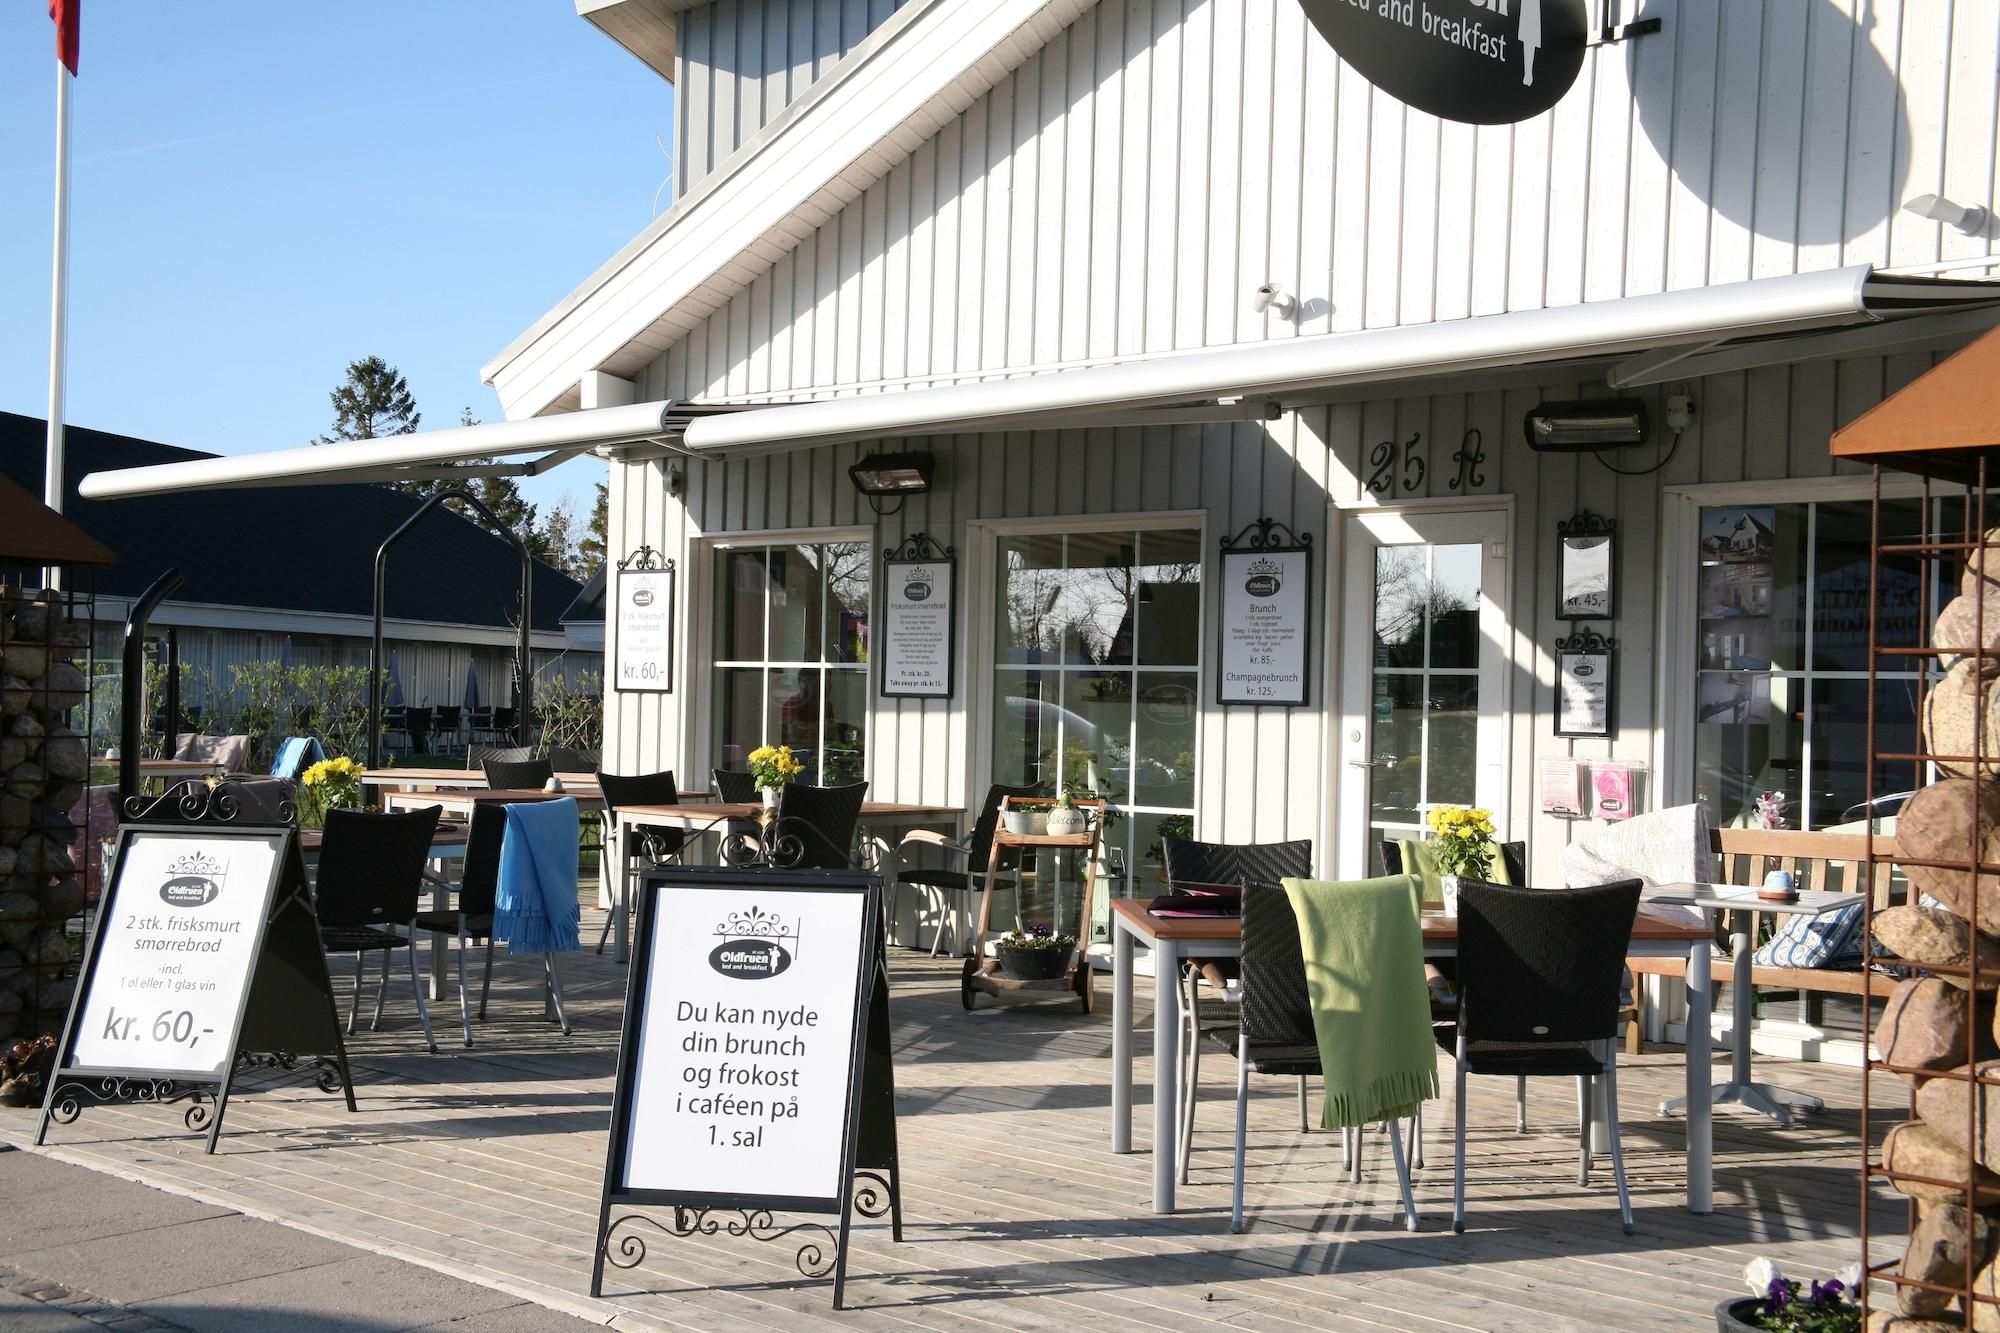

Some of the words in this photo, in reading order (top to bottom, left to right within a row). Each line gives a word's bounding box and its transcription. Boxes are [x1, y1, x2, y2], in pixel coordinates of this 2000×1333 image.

[1378, 0, 1413, 27] and
[1421, 3, 1507, 63] breakfast
[1365, 431, 1425, 492] 25
[1250, 603, 1277, 613] Brunch
[1583, 594, 1606, 608] 45,-
[1250, 656, 1259, 664] kr.
[1261, 656, 1276, 666] 85,-
[624, 661, 638, 679] kr.
[642, 662, 664, 681] 60,-
[1226, 672, 1298, 684] Champagnebrunch
[1246, 686, 1256, 695] kr.
[1258, 687, 1276, 697] 125,-
[168, 885, 203, 896] Oldfruen
[126, 915, 136, 929] 2
[138, 915, 163, 931] stk.
[167, 915, 241, 933] frisksmurt
[133, 937, 221, 953] smørrebrød
[720, 951, 768, 964] Oldfruen
[158, 963, 183, 975] -incl.
[121, 977, 126, 988] 1
[128, 977, 138, 988] øl
[140, 978, 164, 989] eller
[167, 979, 172, 989] 1
[174, 979, 197, 993] glas
[199, 981, 216, 991] vin
[676, 1001, 708, 1022] Du
[715, 1002, 755, 1025] kan
[762, 1005, 818, 1031] nyde
[103, 1006, 141, 1041] kr.
[152, 1010, 214, 1049] 60,-
[682, 1031, 718, 1053] din
[725, 1032, 806, 1056] brunch
[682, 1066, 712, 1089] og
[718, 1063, 800, 1087] frokost
[676, 1092, 683, 1113] i
[688, 1093, 764, 1117] caféen
[770, 1095, 799, 1123] på
[707, 1125, 725, 1146] 1.
[731, 1126, 763, 1148] sal
